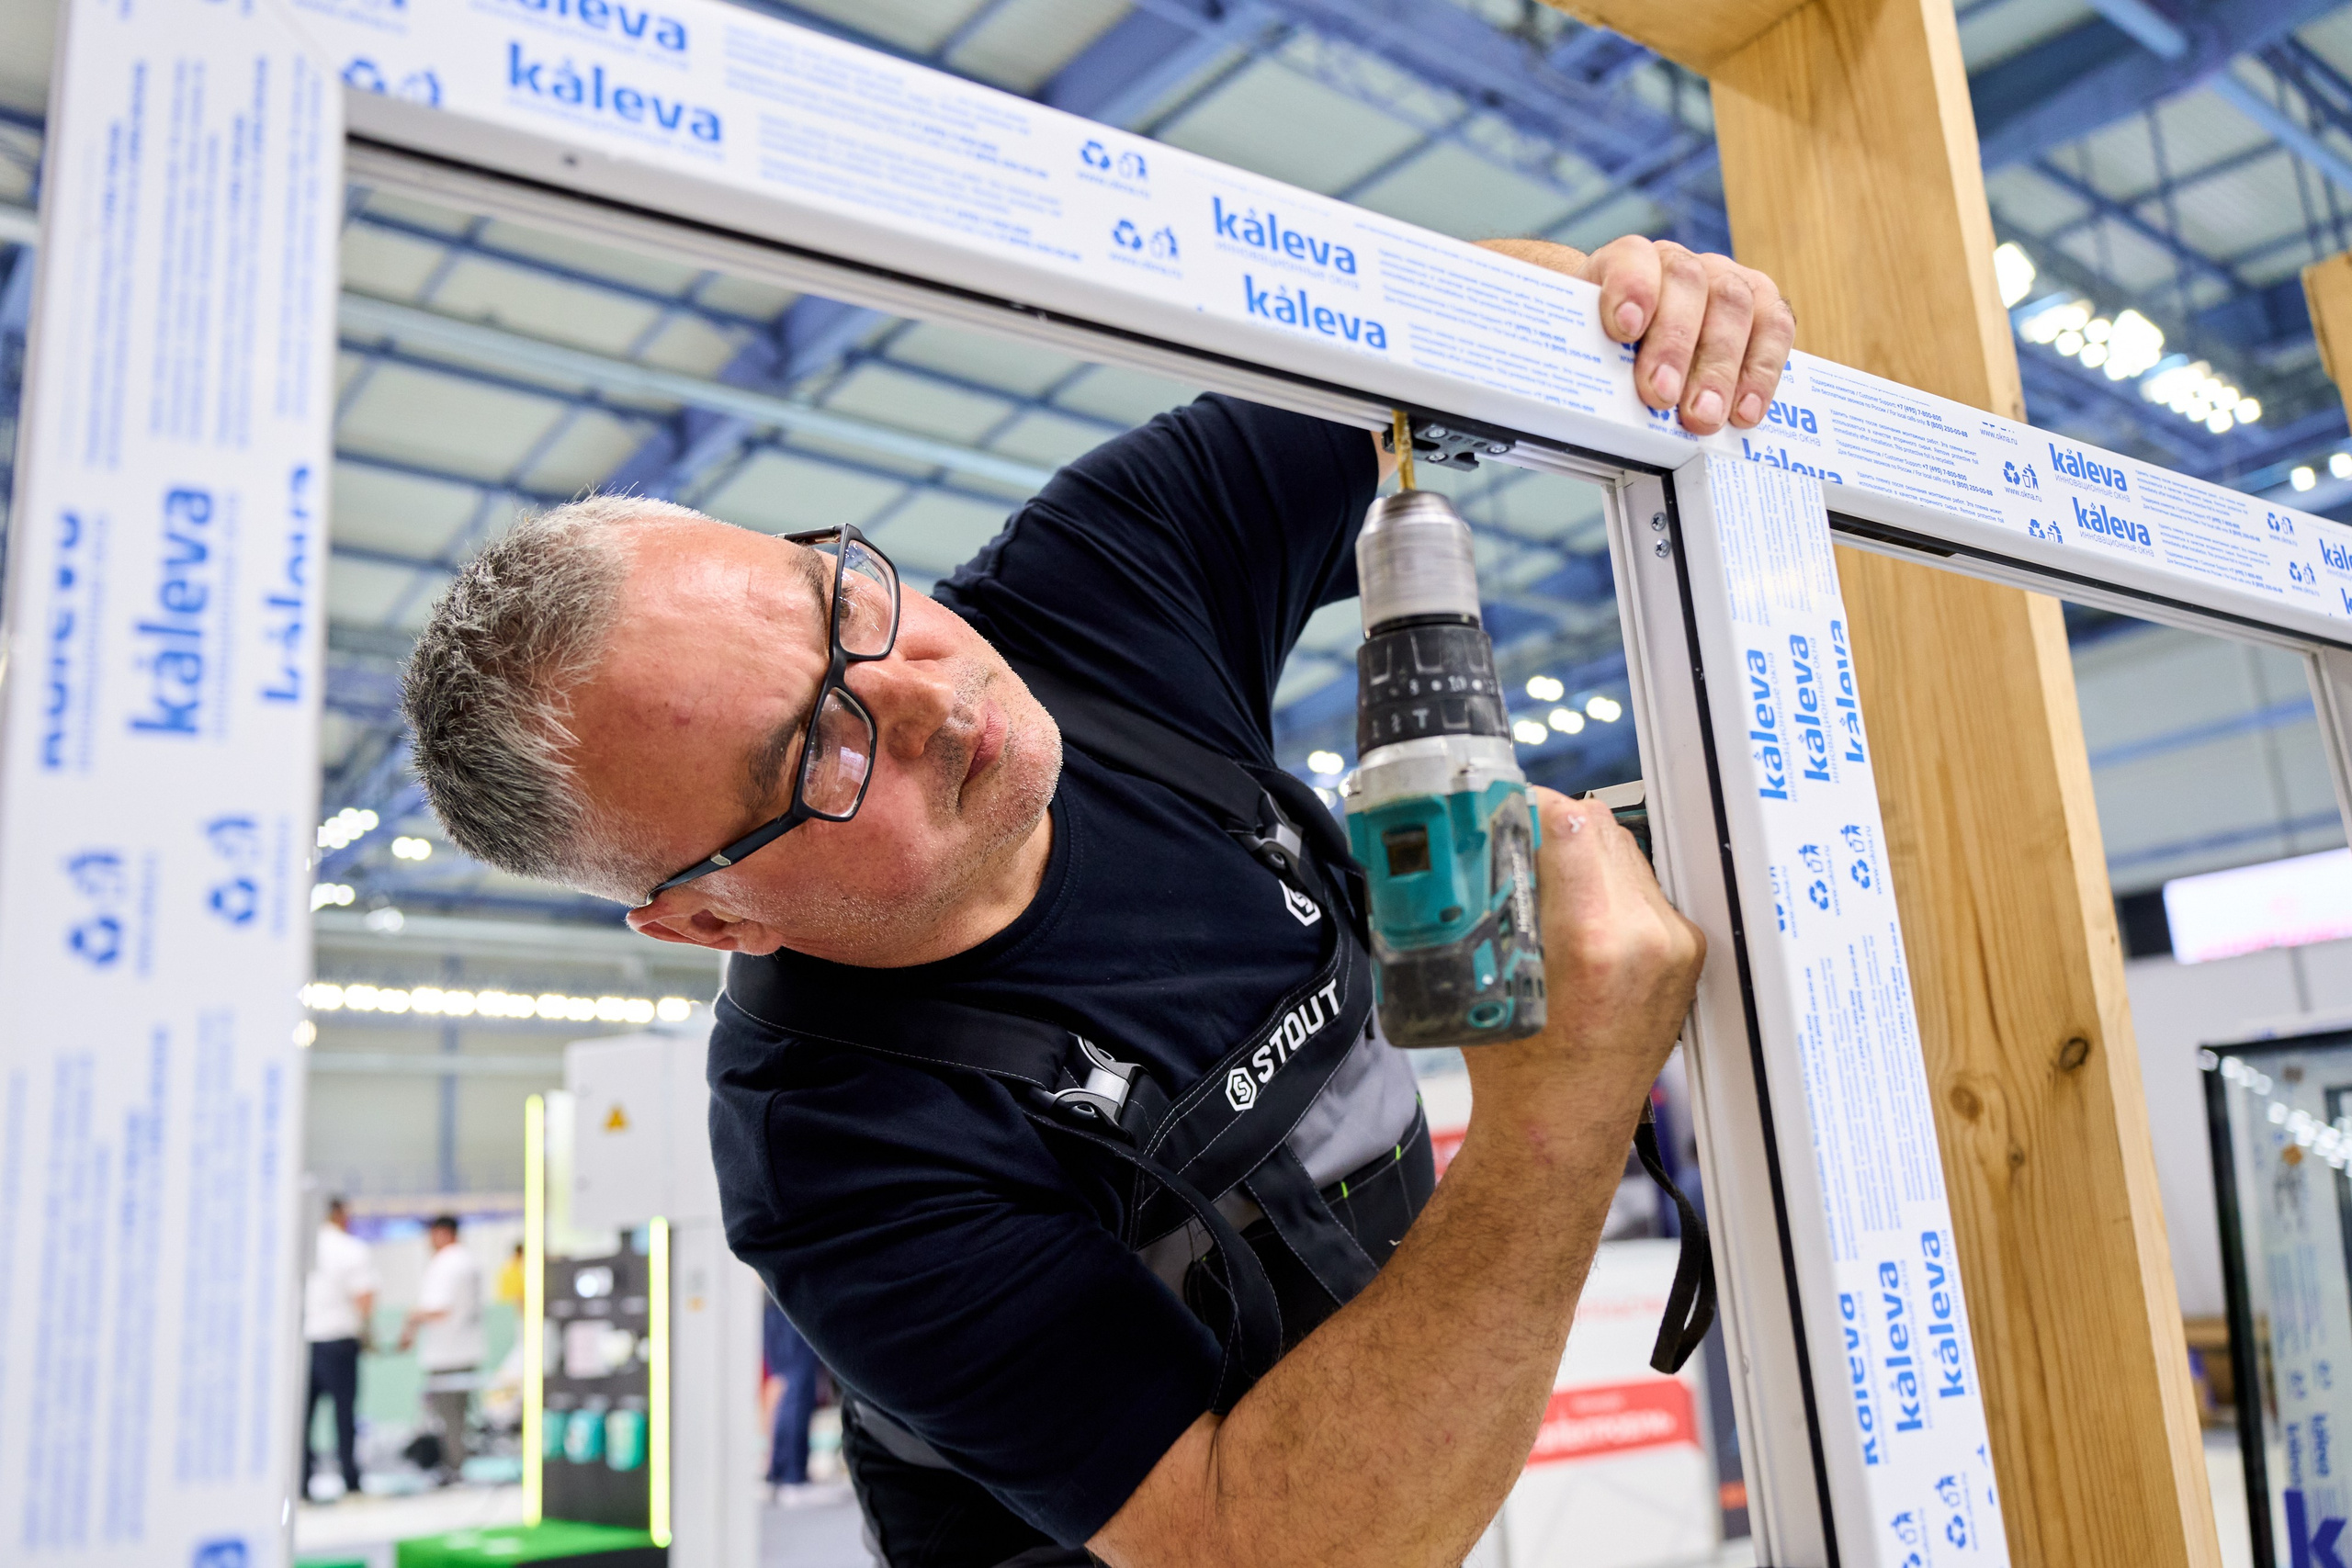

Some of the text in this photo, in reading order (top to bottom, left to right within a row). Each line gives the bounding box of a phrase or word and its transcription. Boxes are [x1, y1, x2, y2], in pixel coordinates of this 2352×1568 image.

[516, 0, 687, 51] eva
[1766, 399, 1818, 434] eva
[2054, 474, 2132, 502] инновационные окна
[2079, 530, 2138, 553] инновационные
[1252, 978, 1340, 1083] STOUT
